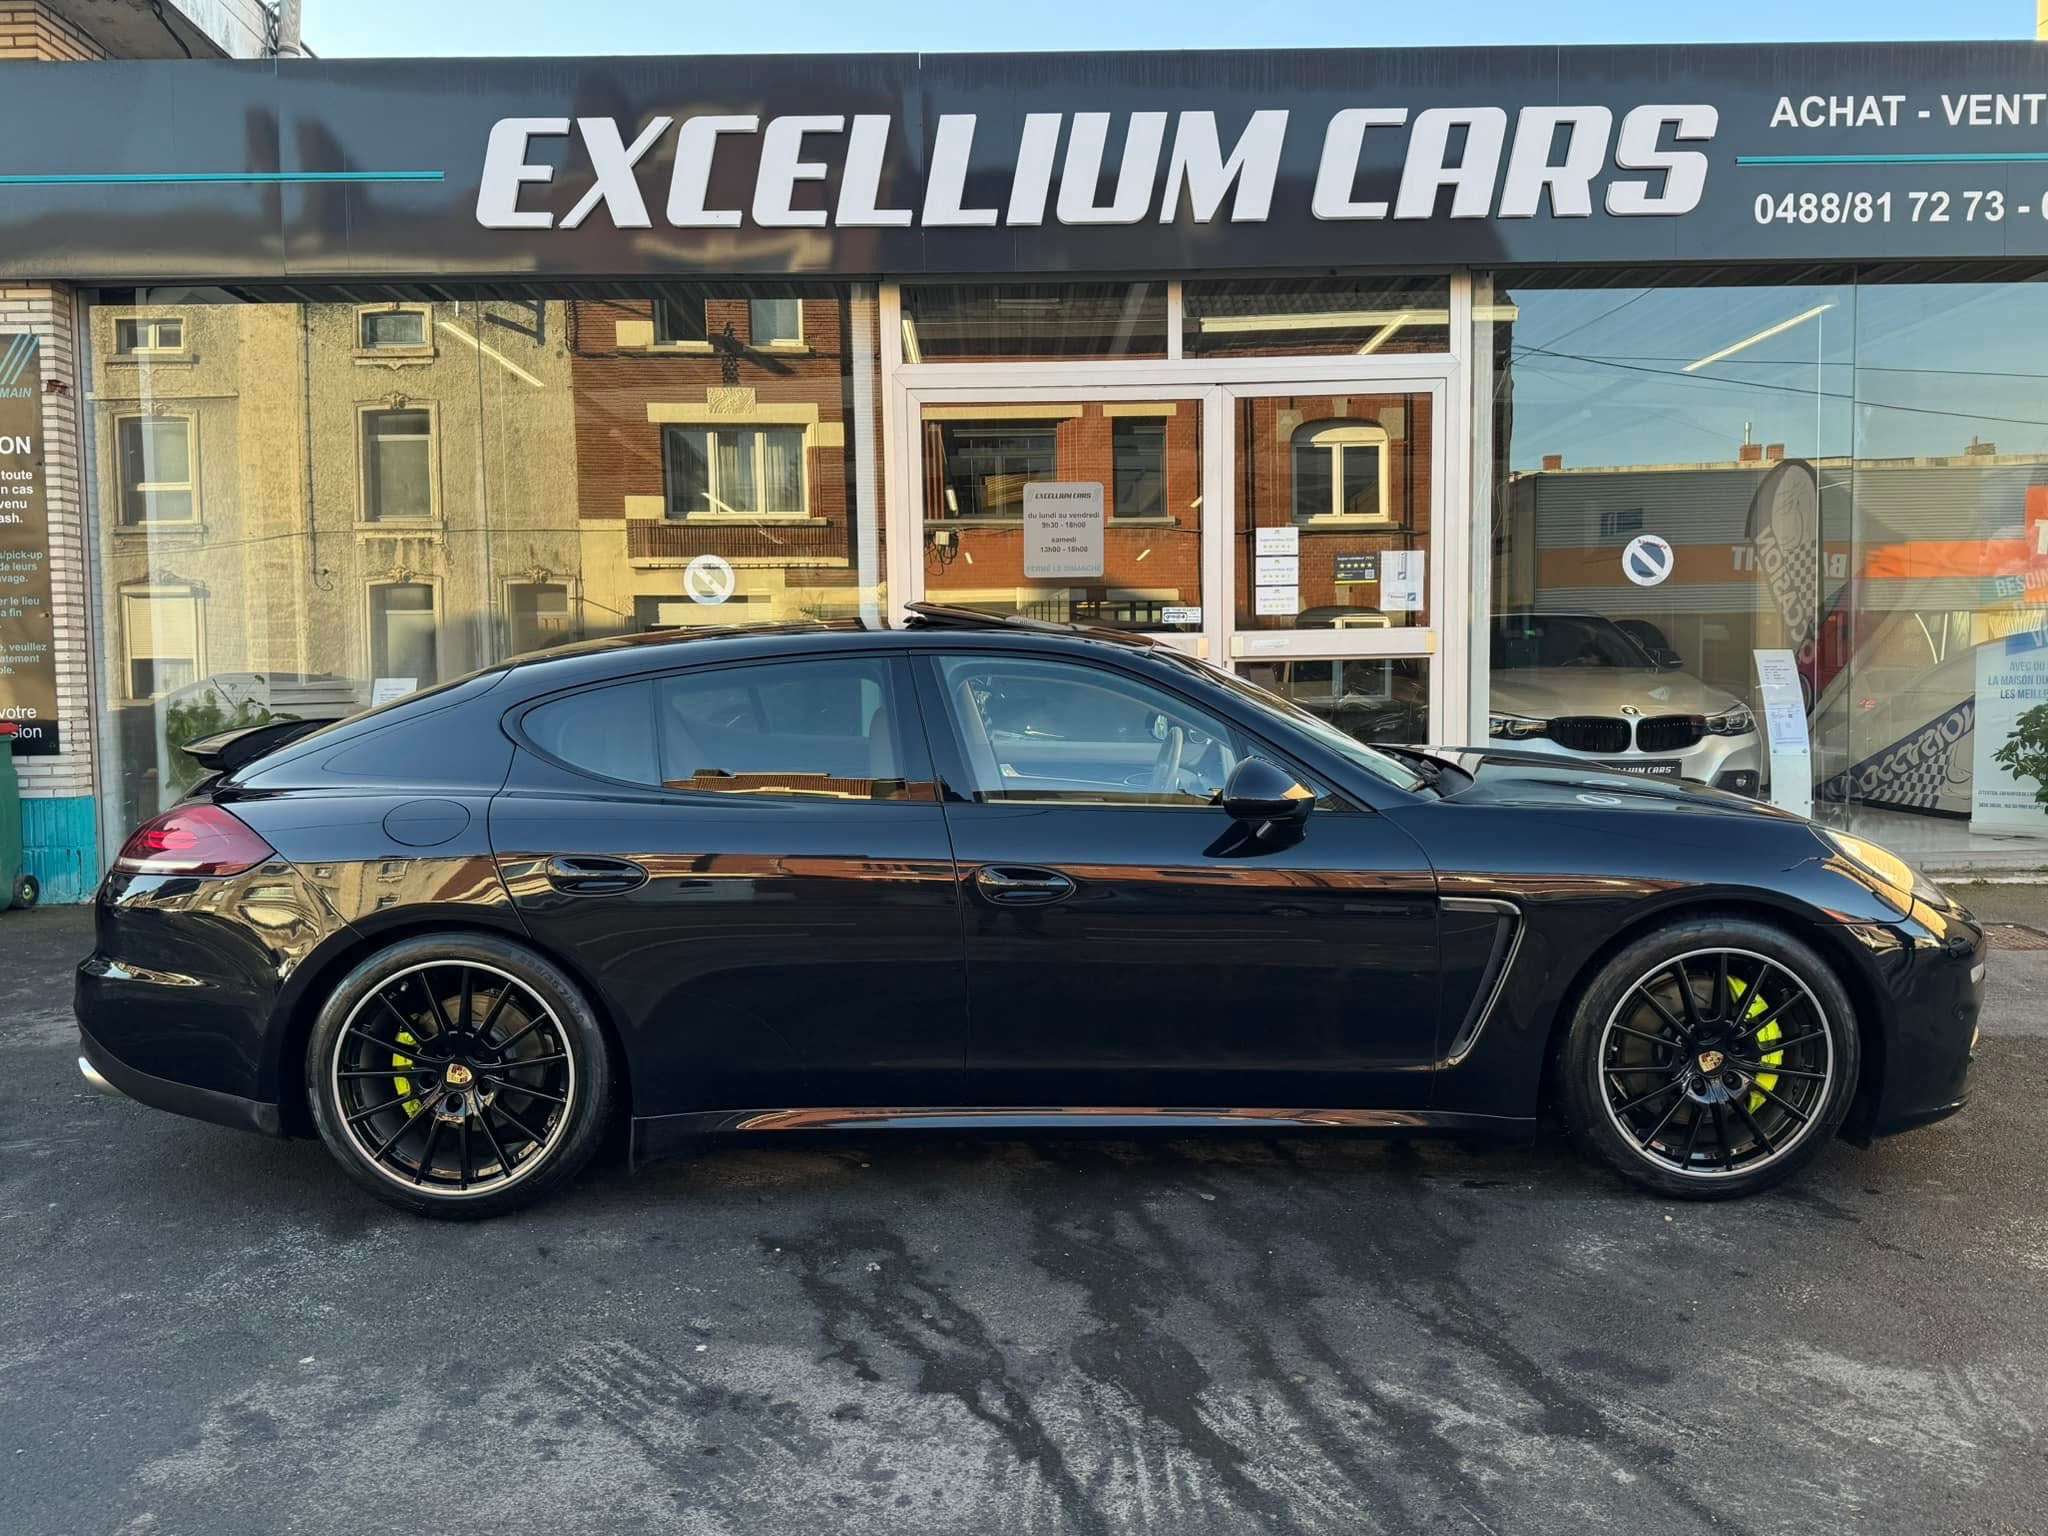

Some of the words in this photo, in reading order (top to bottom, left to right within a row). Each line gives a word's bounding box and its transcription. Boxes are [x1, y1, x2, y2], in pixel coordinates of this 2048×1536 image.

[1769, 95, 1906, 128] ACHAT
[1918, 110, 1931, 119] -
[1941, 93, 2047, 126] VENT
[475, 110, 1290, 230] EXCELLIUM
[1310, 104, 1719, 220] CARS
[1754, 191, 1892, 225] 0488/81
[1908, 191, 1950, 223] 72
[1962, 190, 2005, 222] 73
[0, 436, 32, 455] ON
[1, 469, 33, 481] toute
[12, 485, 34, 495] cas
[1039, 511, 1057, 519] lundi
[10, 597, 19, 606] le
[21, 597, 40, 606] lieu
[9, 608, 22, 618] fin
[9, 643, 48, 652] veuillez
[1987, 675, 1999, 686] LA
[2000, 674, 2033, 686] MAISON
[2000, 688, 2016, 700] LES
[0, 704, 38, 719] votre
